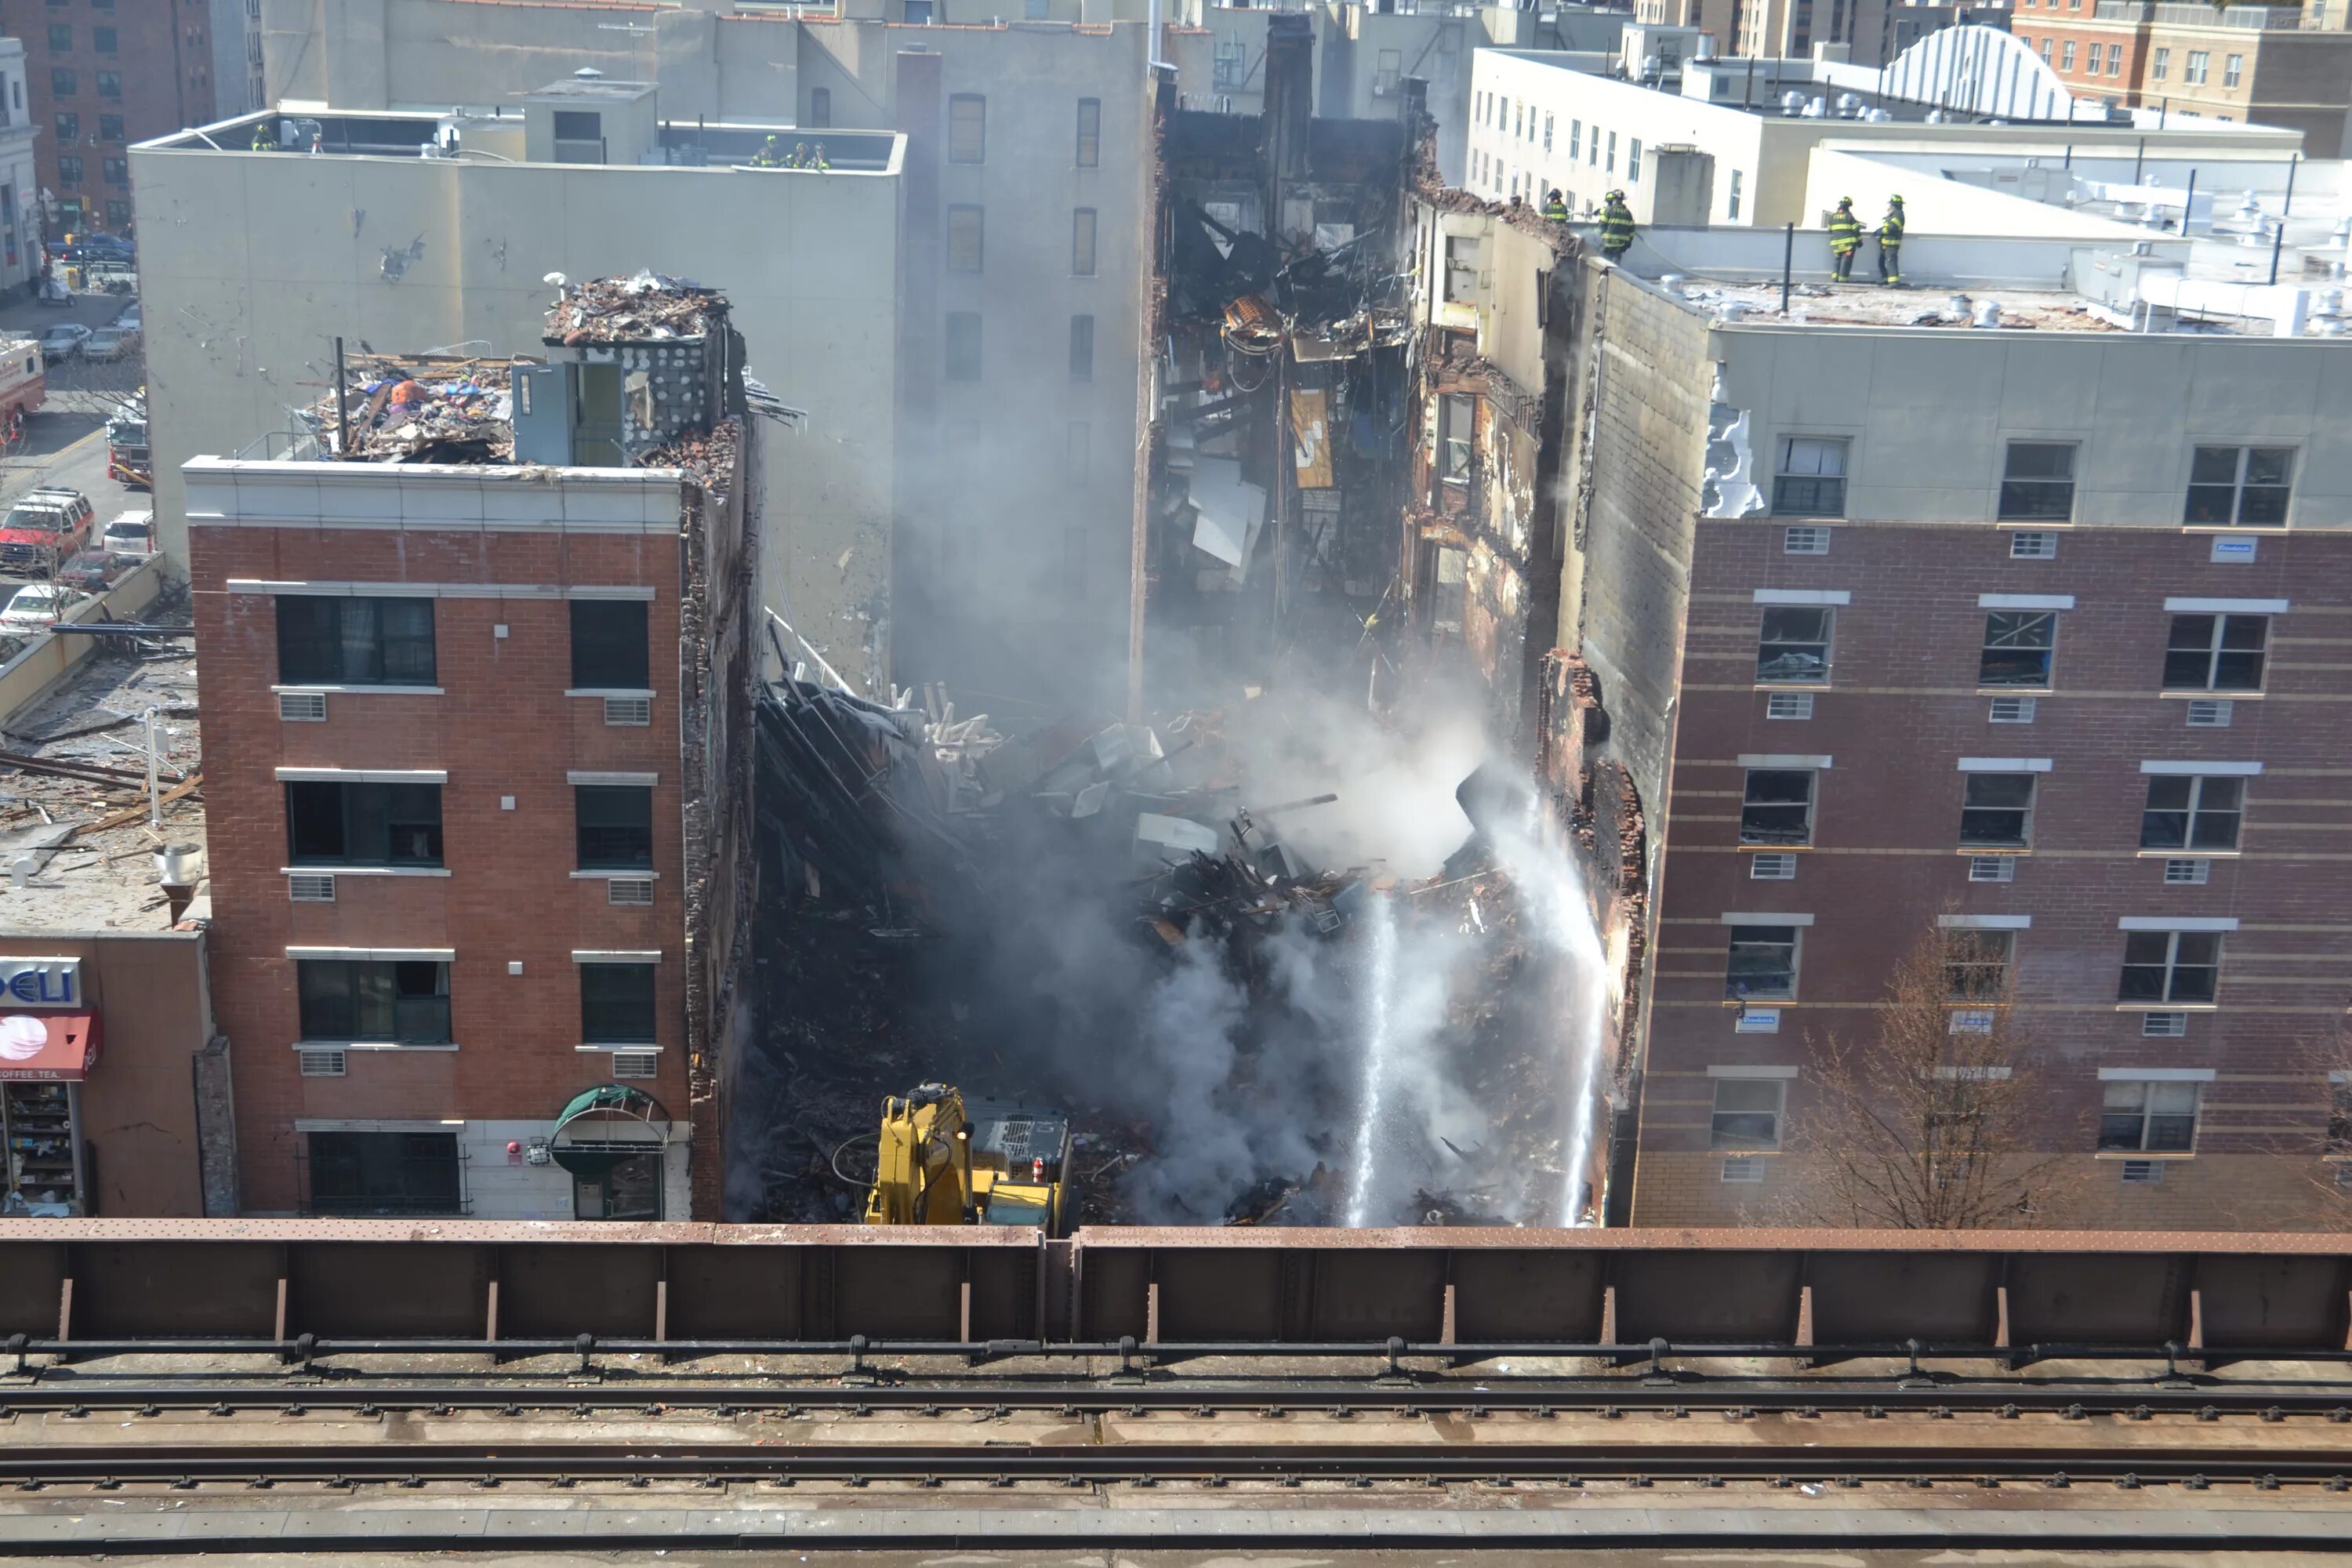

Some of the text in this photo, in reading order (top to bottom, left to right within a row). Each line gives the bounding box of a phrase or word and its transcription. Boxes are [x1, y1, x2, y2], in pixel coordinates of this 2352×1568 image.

[0, 969, 73, 1003] ELI
[0, 1070, 60, 1079] OFFEE. TEA.
